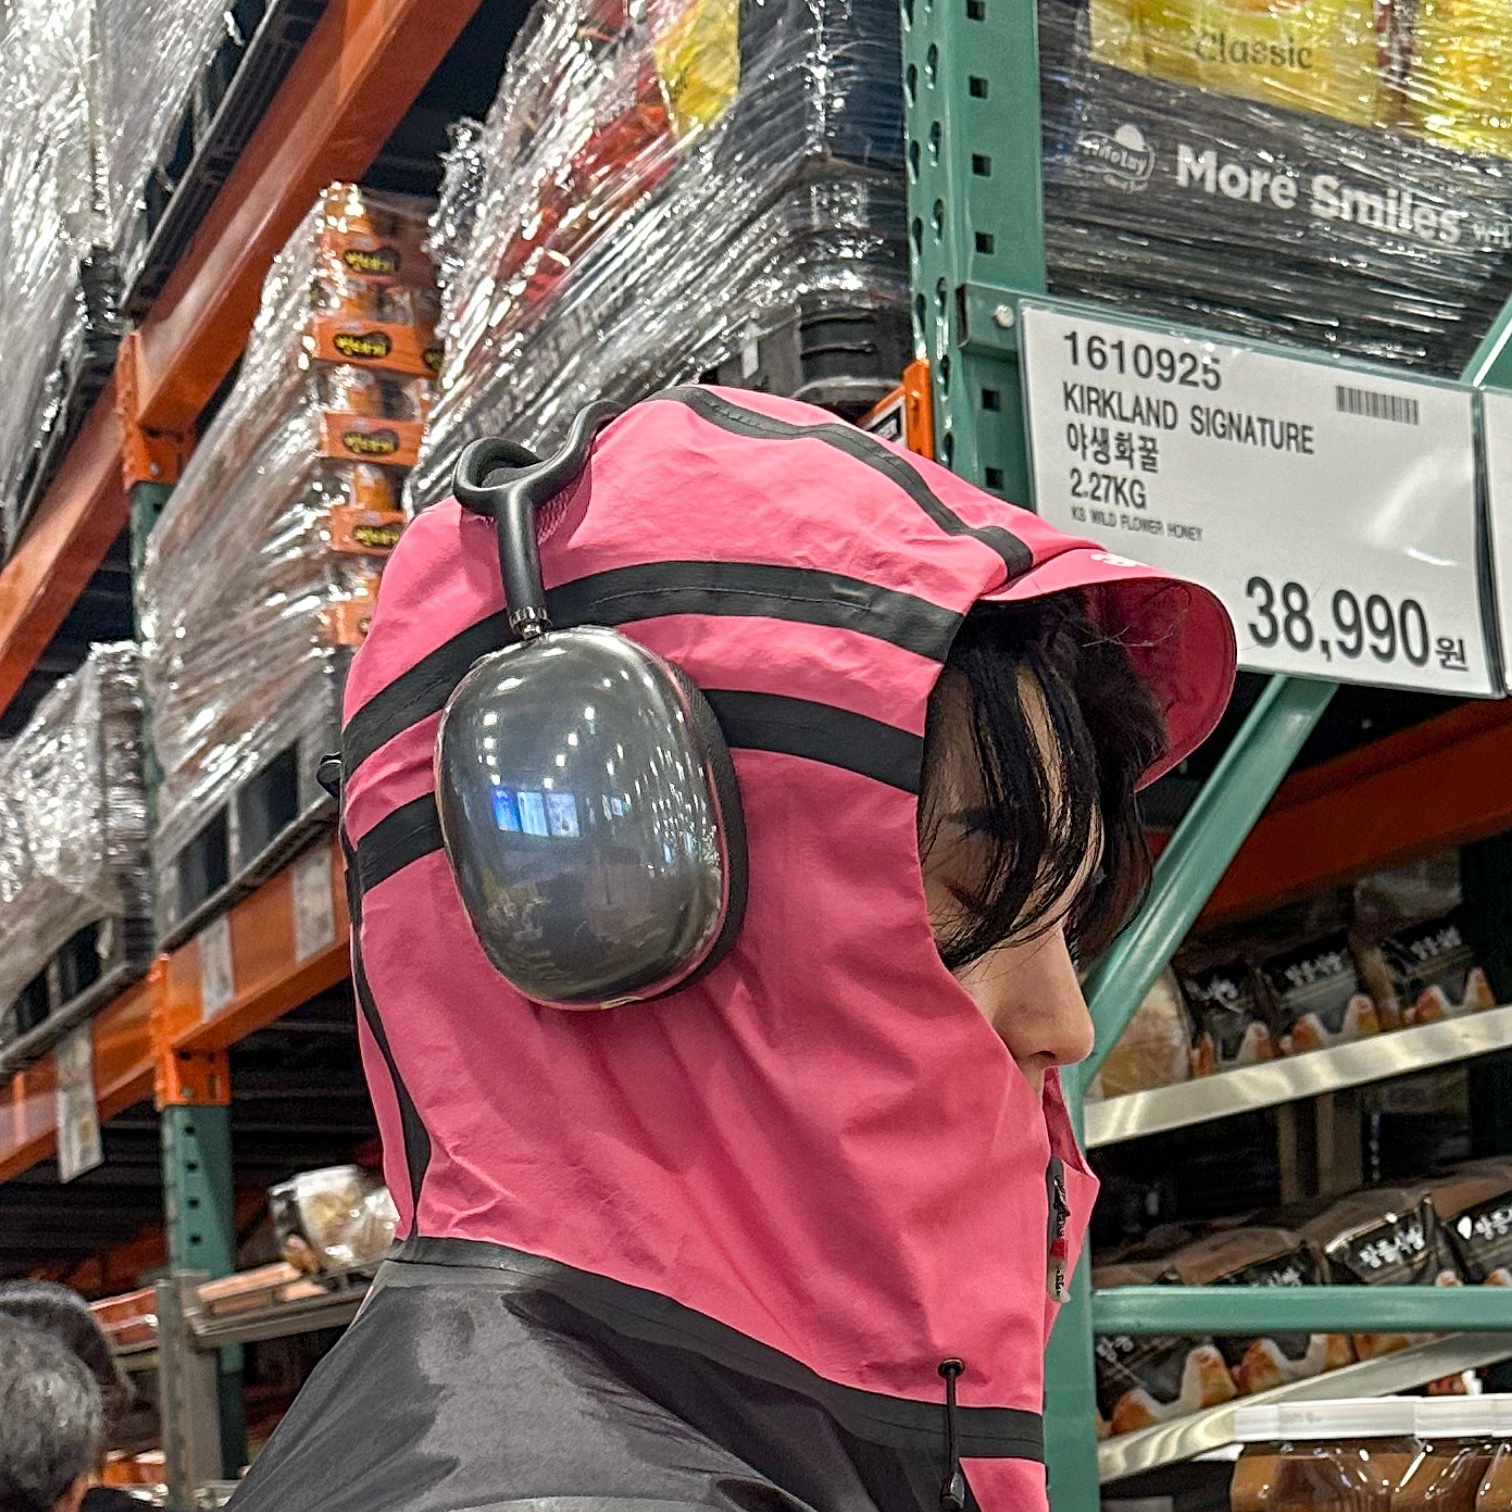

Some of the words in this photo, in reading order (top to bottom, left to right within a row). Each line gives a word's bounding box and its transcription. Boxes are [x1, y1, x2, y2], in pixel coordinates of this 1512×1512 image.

[1199, 30, 1313, 70] Classic
[1177, 144, 1297, 210] More
[1311, 174, 1461, 245] Smiles
[1063, 331, 1223, 391] 1610925
[1062, 381, 1178, 431] KIRKLAND
[1190, 405, 1315, 455] SIGNATURE
[1067, 423, 1159, 473] 야생화꿀
[1069, 468, 1147, 509] 2.27KG
[1120, 513, 1164, 537] FLOWER
